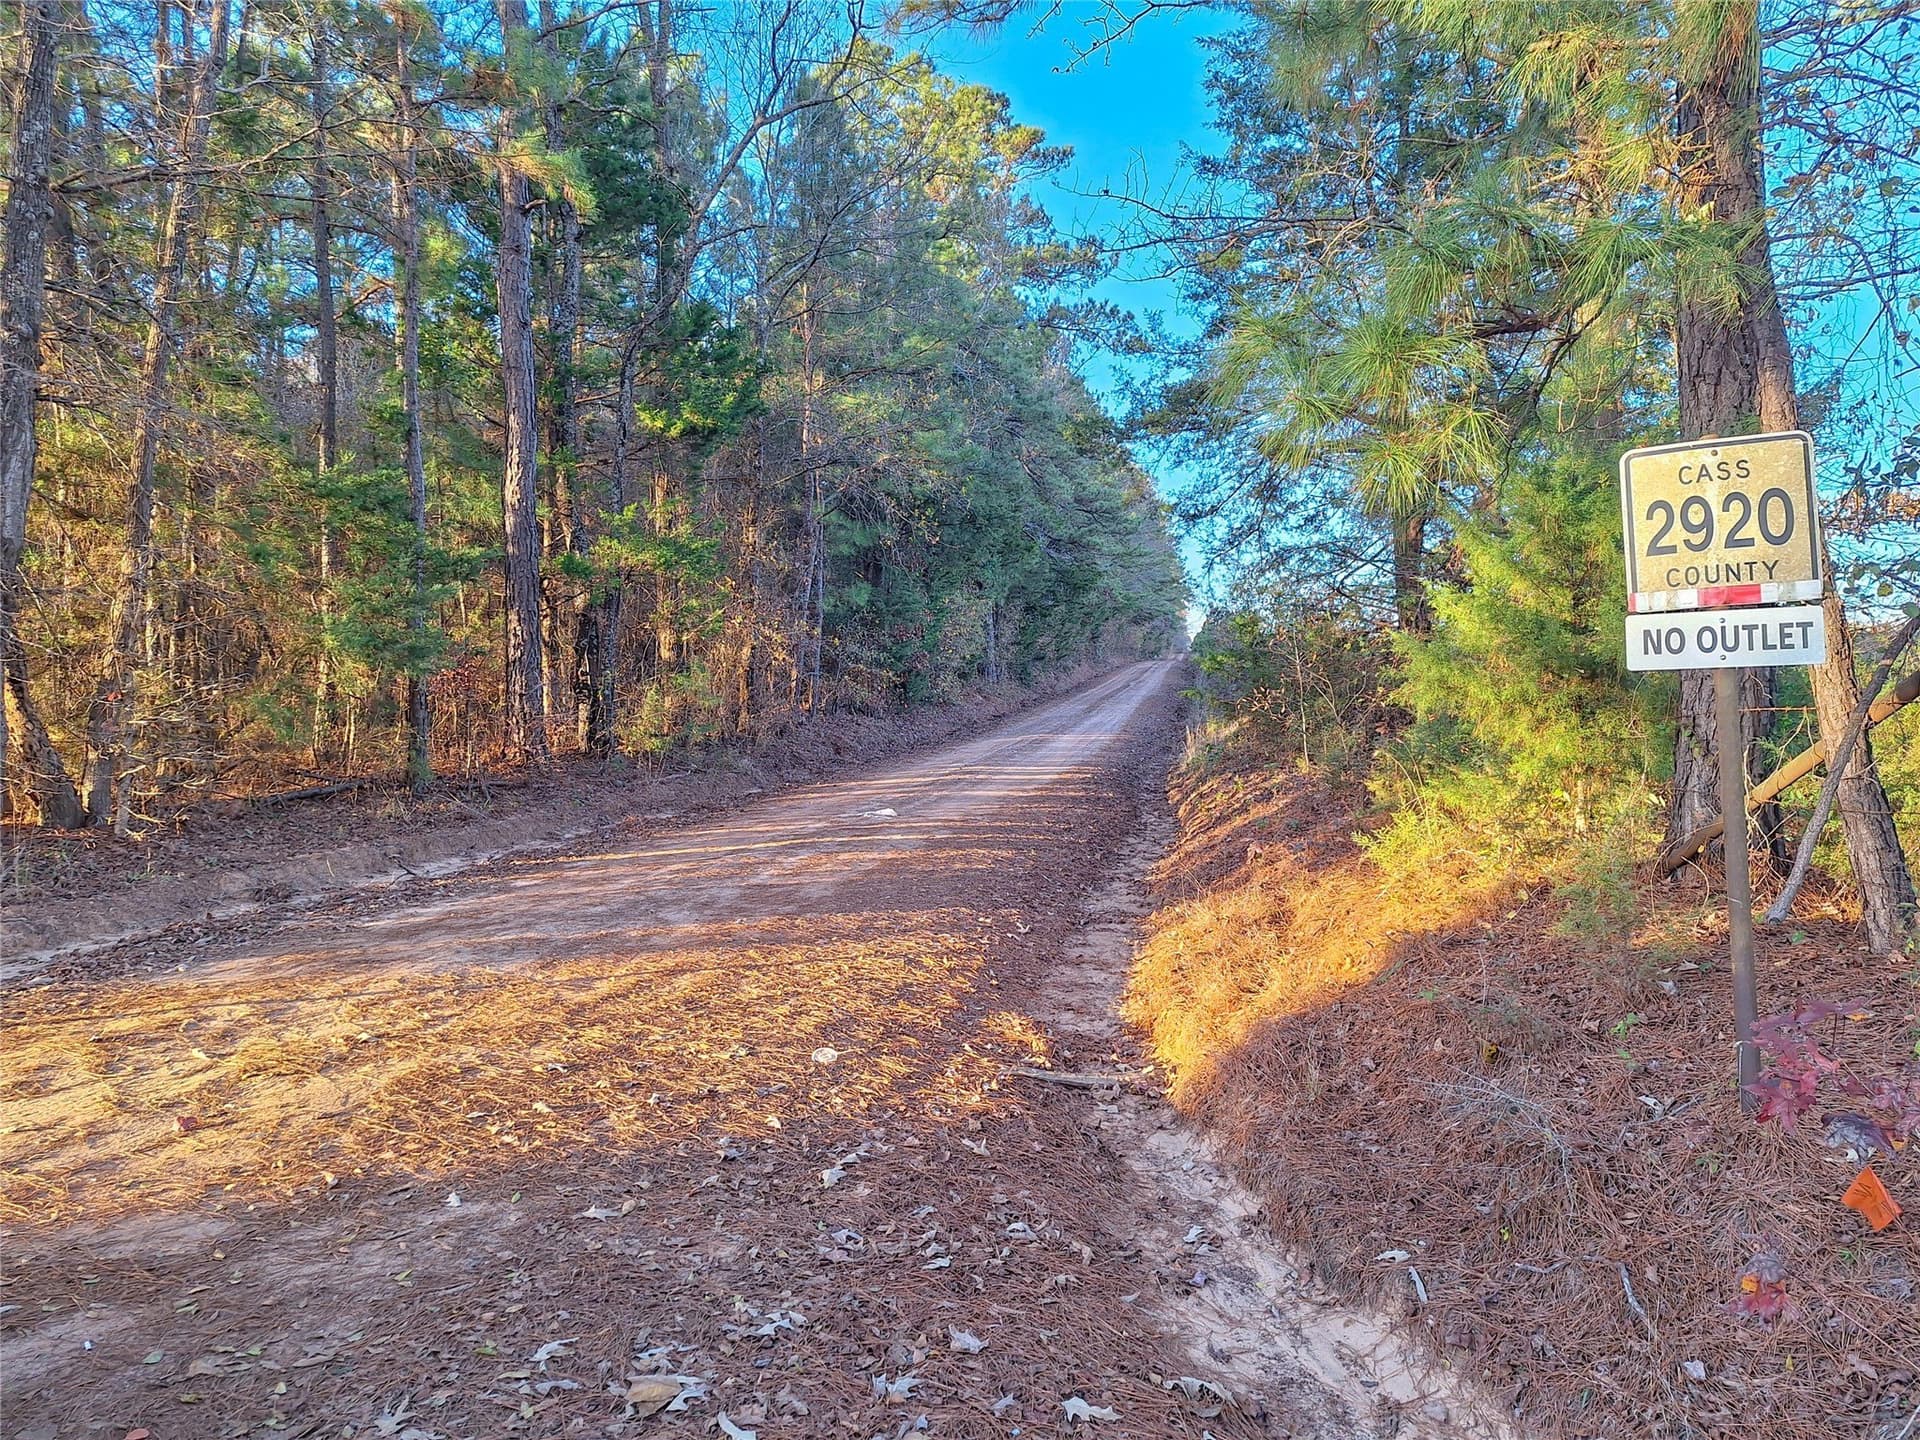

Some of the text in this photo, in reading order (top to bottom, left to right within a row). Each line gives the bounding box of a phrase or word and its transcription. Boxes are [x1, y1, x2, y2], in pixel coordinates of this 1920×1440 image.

[1678, 459, 1751, 485] CASS
[1645, 487, 1795, 557] 2920
[1666, 559, 1780, 588] COUNTY
[1642, 621, 1814, 655] NO OUTLET
